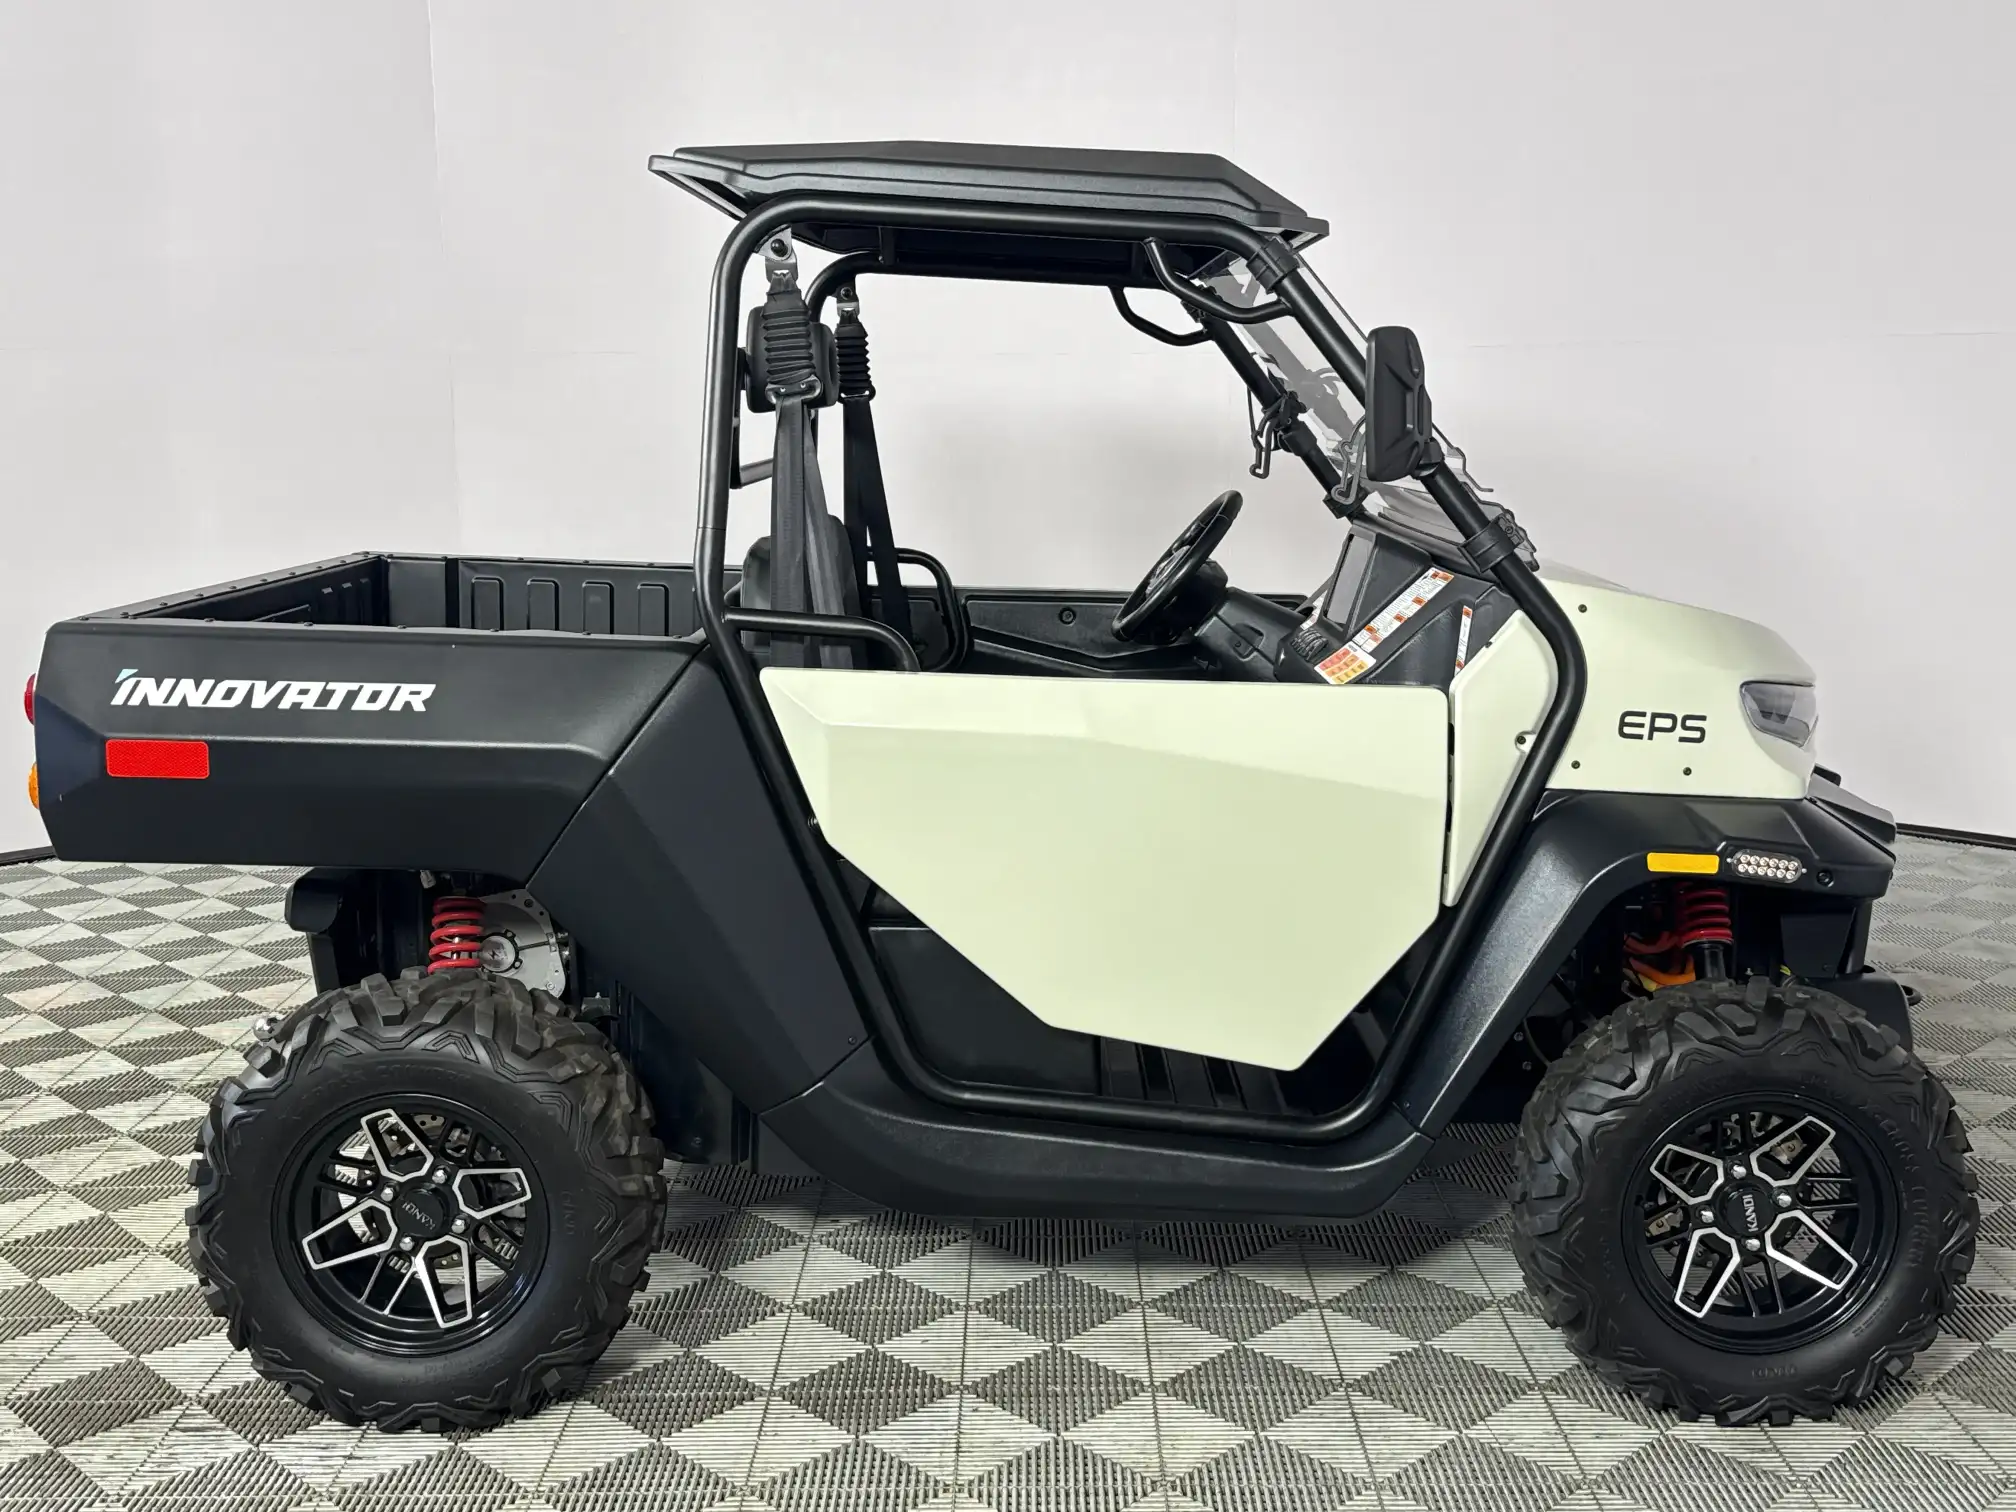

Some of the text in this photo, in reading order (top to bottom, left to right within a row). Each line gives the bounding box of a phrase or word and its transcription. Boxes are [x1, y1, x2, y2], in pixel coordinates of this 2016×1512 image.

[110, 668, 436, 712] INNOVATOR
[1618, 710, 1707, 744] EPS
[401, 1201, 436, 1231] KANDI
[1741, 1194, 1759, 1232] KANDI
